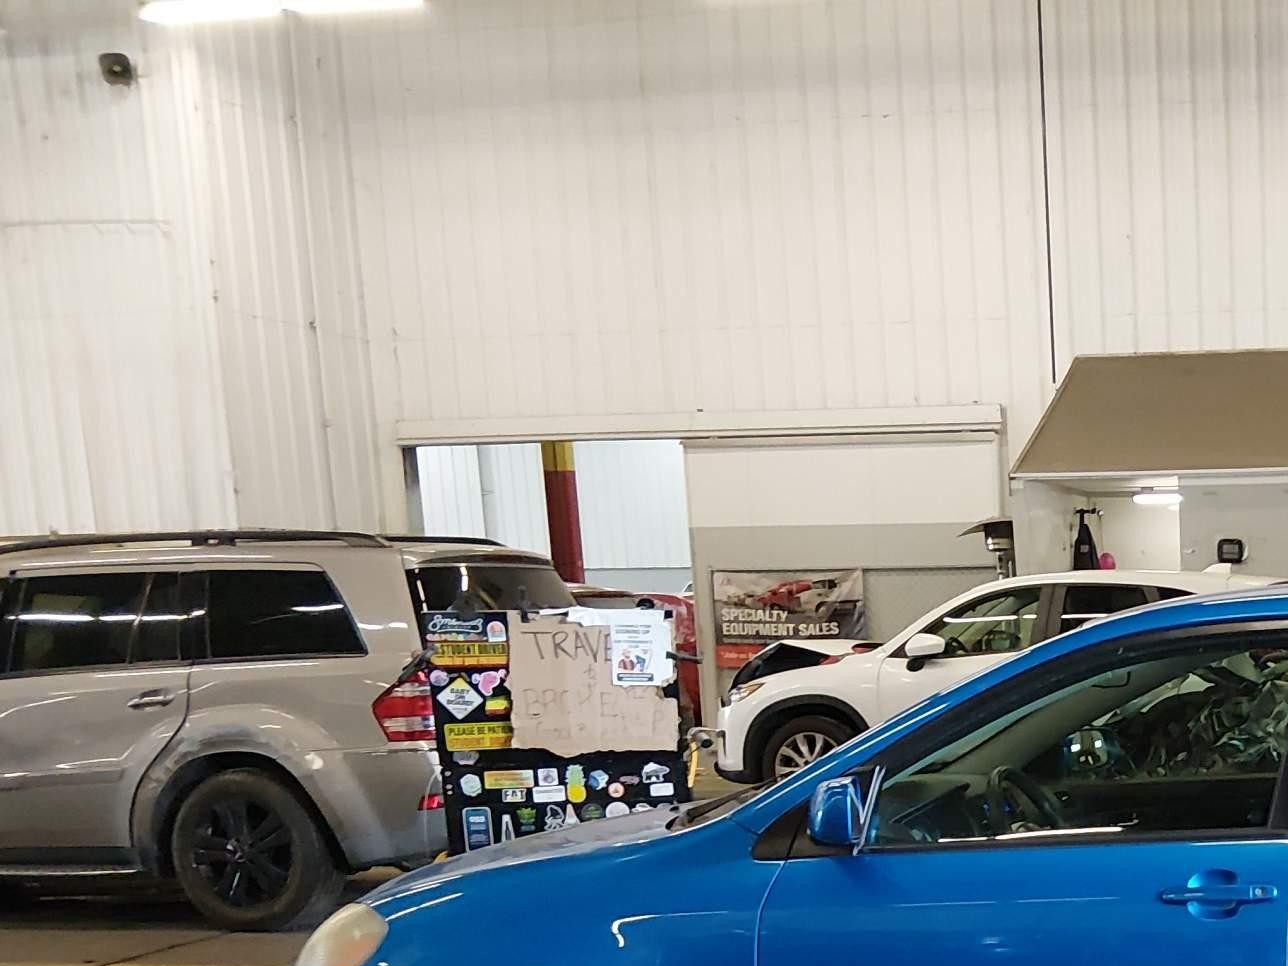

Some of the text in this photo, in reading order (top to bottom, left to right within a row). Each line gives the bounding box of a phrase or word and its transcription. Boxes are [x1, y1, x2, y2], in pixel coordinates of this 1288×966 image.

[722, 608, 788, 622] SPECIALTY
[722, 622, 840, 636] EQUIPMENT SALES
